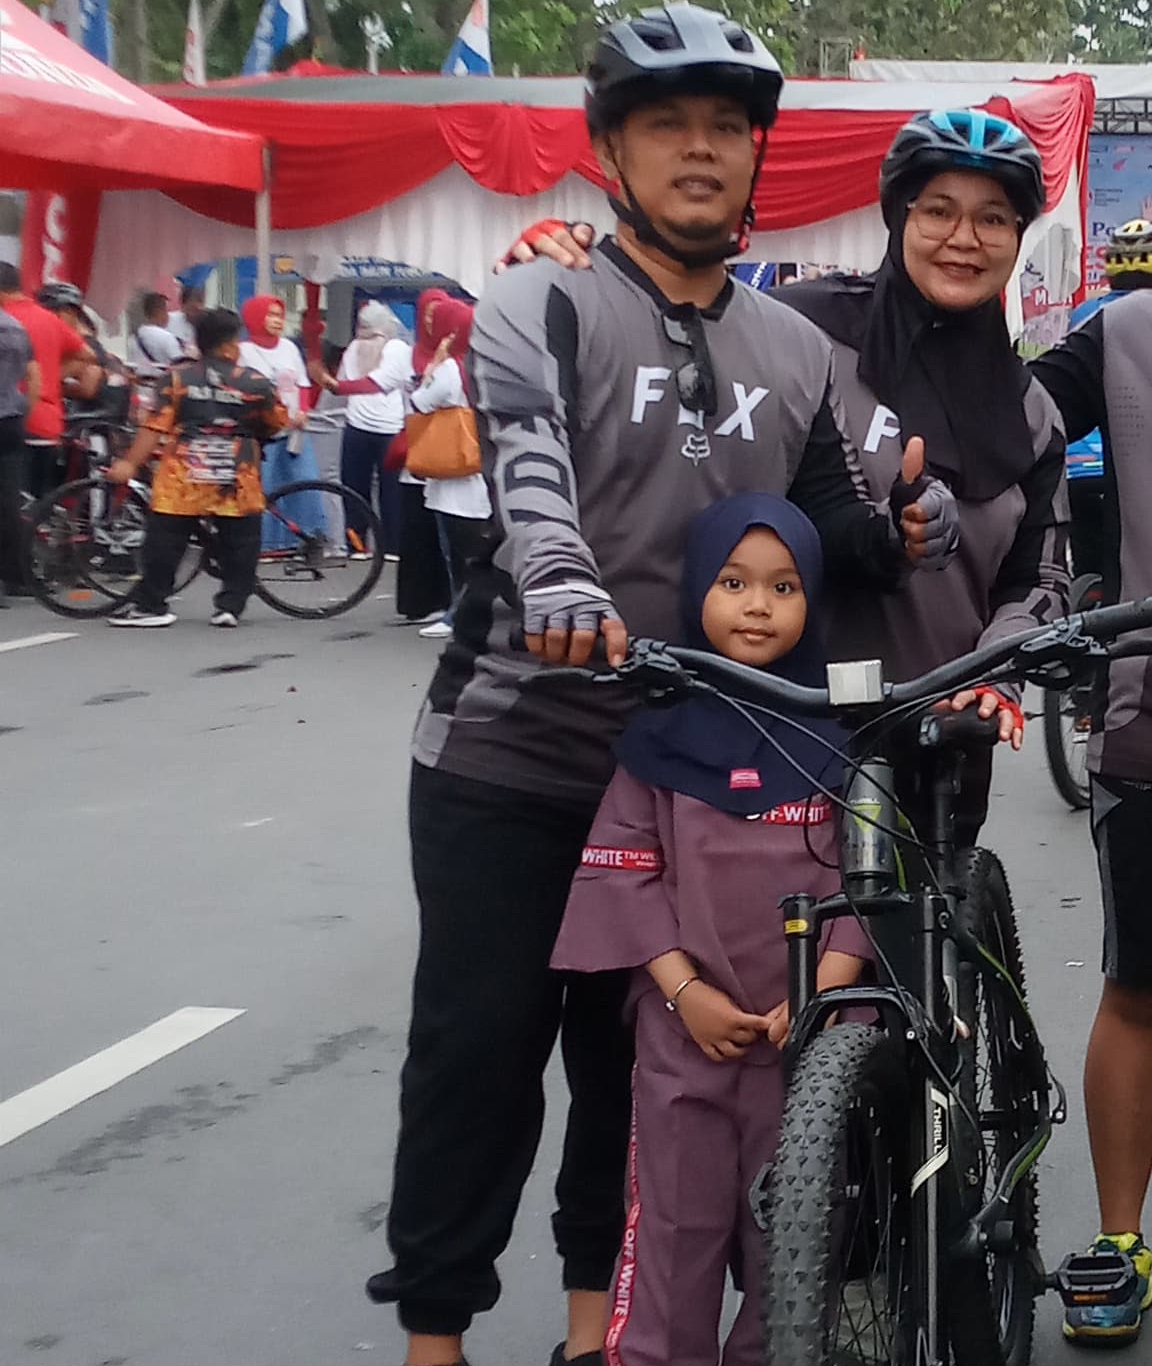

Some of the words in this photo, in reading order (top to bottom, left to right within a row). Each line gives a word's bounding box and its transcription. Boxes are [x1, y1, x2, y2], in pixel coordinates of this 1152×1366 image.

[629, 365, 770, 442] FX
[582, 847, 622, 866] WHITE
[932, 1106, 942, 1155] THRILL
[614, 1263, 635, 1316] WHITE
